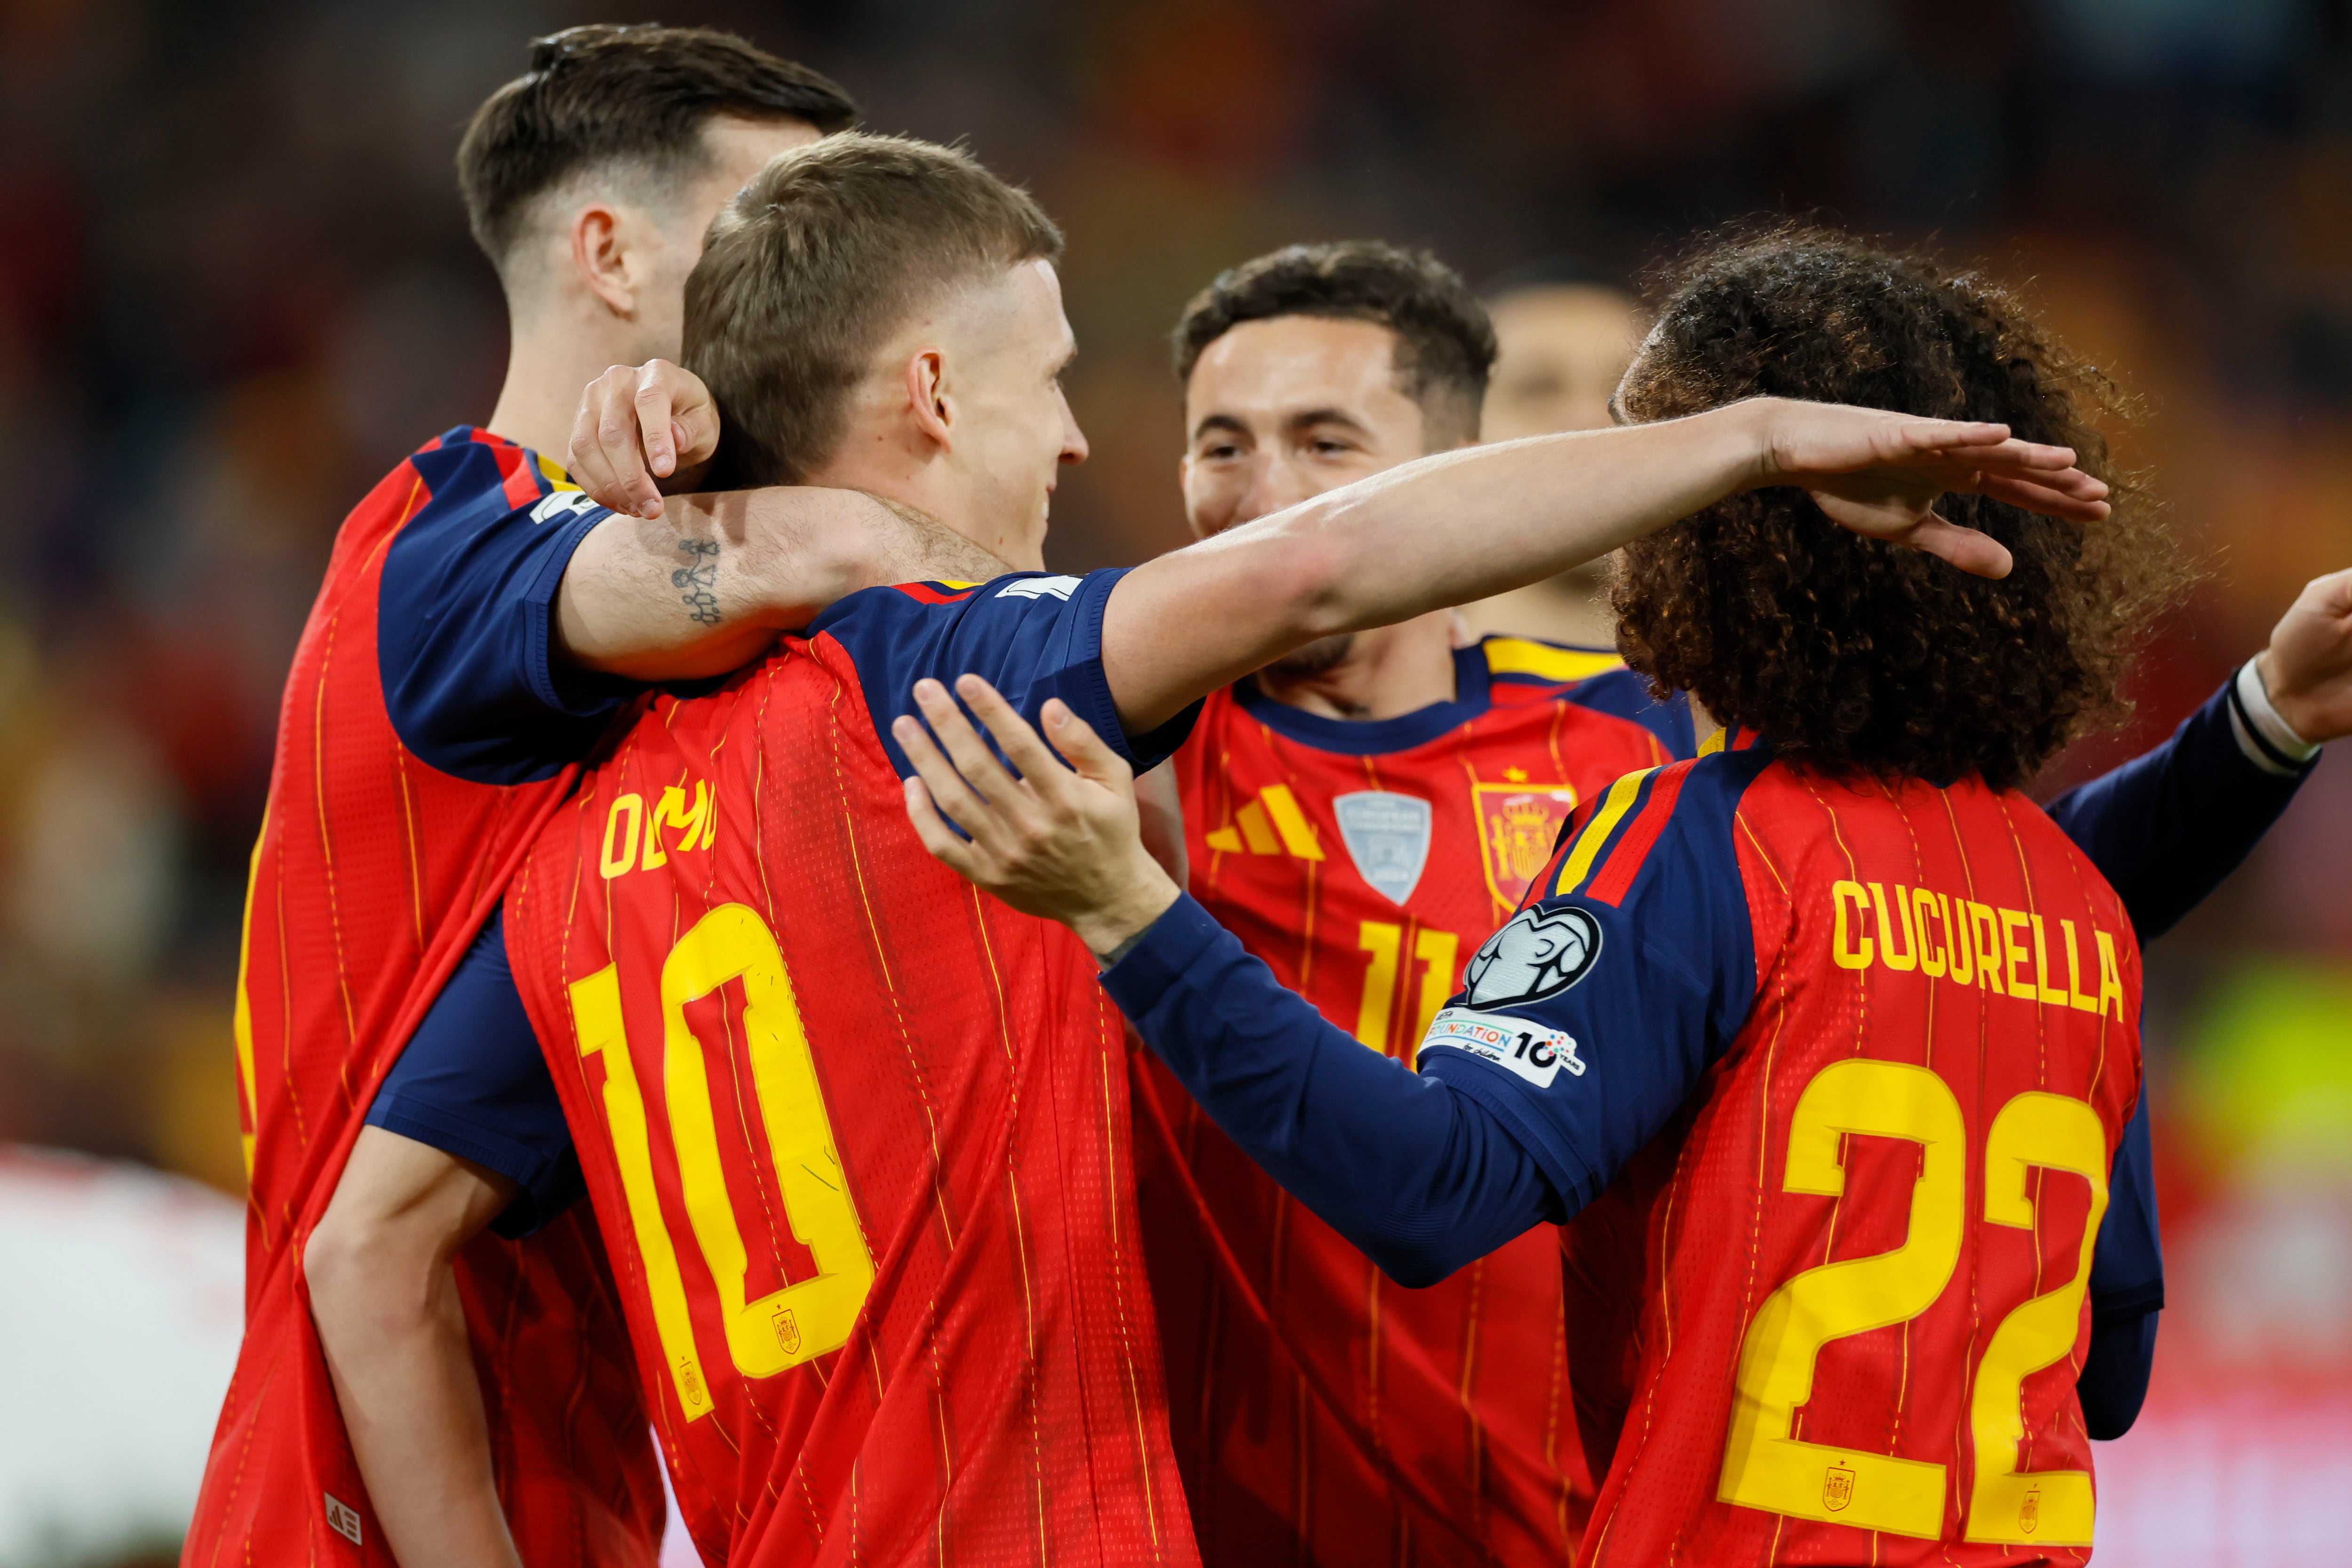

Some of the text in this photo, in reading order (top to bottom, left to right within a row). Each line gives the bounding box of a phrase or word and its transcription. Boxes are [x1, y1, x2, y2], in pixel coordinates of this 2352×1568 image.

[1357, 920, 1459, 1075] 11
[1832, 879, 2123, 1024] CUCURELLA
[1514, 1032, 1557, 1068] 10
[1559, 1054, 1580, 1070] YEARS
[569, 902, 875, 1424] 10
[1716, 1058, 2109, 1546] 22
